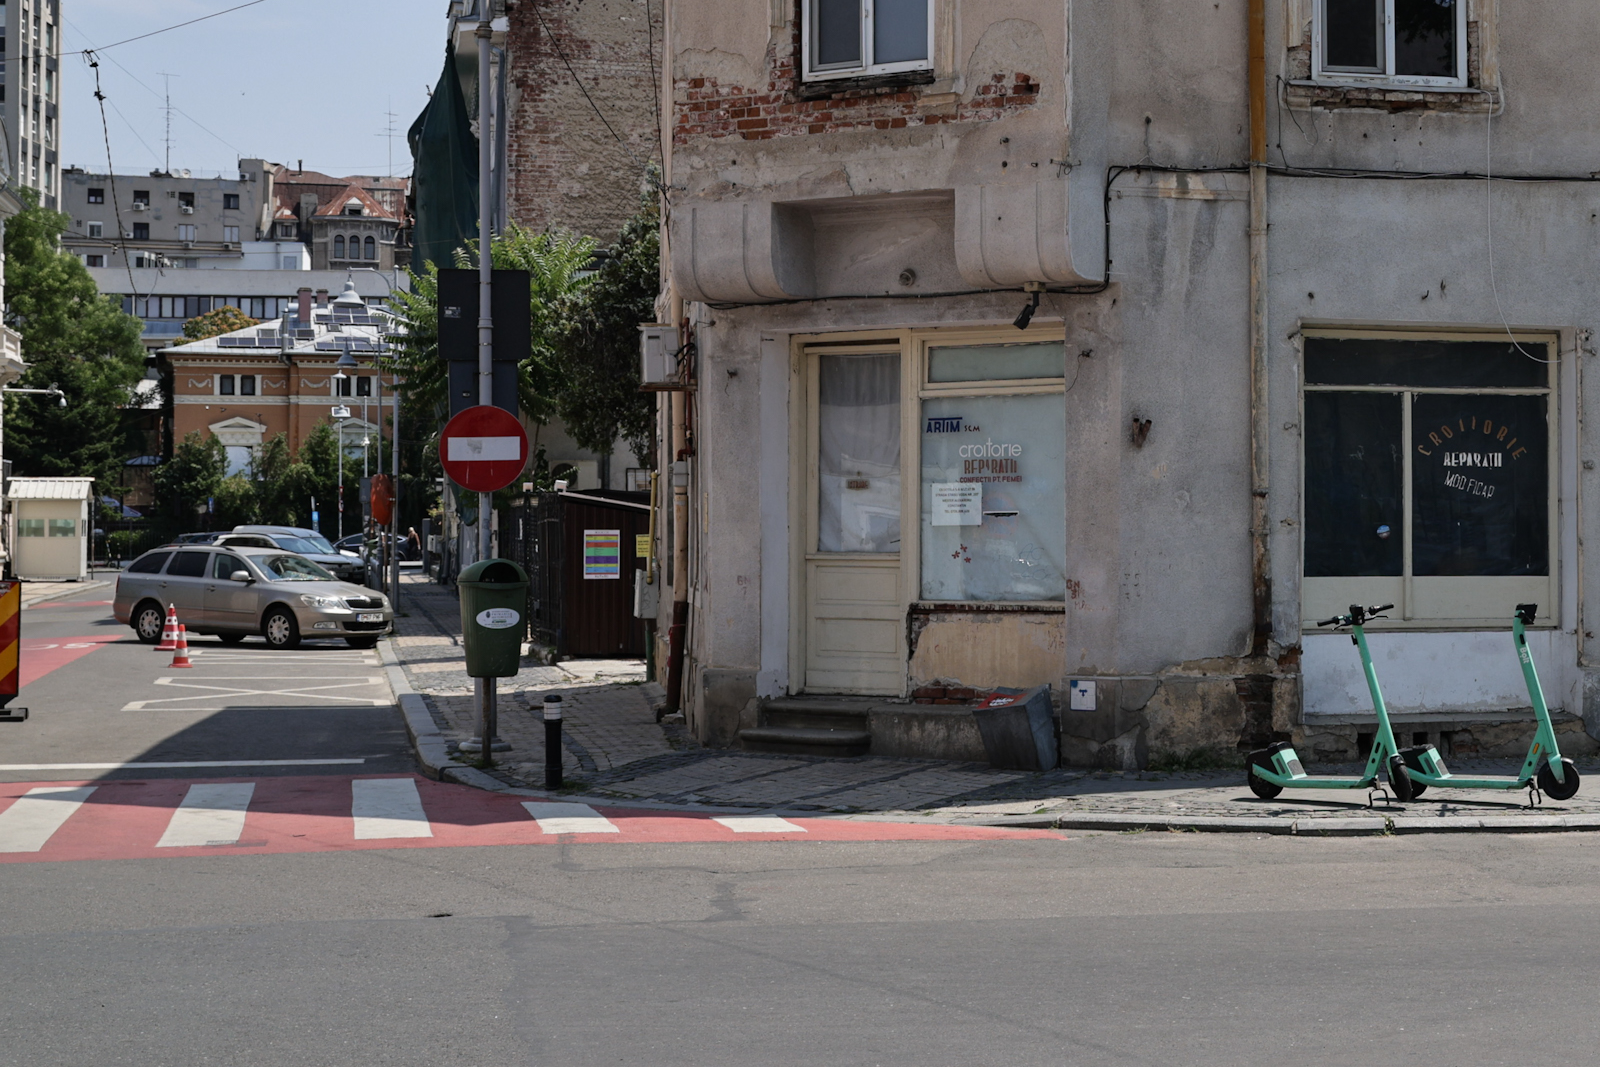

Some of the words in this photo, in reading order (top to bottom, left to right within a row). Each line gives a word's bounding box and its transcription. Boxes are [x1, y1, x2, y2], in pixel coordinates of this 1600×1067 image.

[926, 417, 963, 433] ARTIM
[959, 437, 1022, 458] croitorie
[1520, 646, 1530, 664] Bolt
